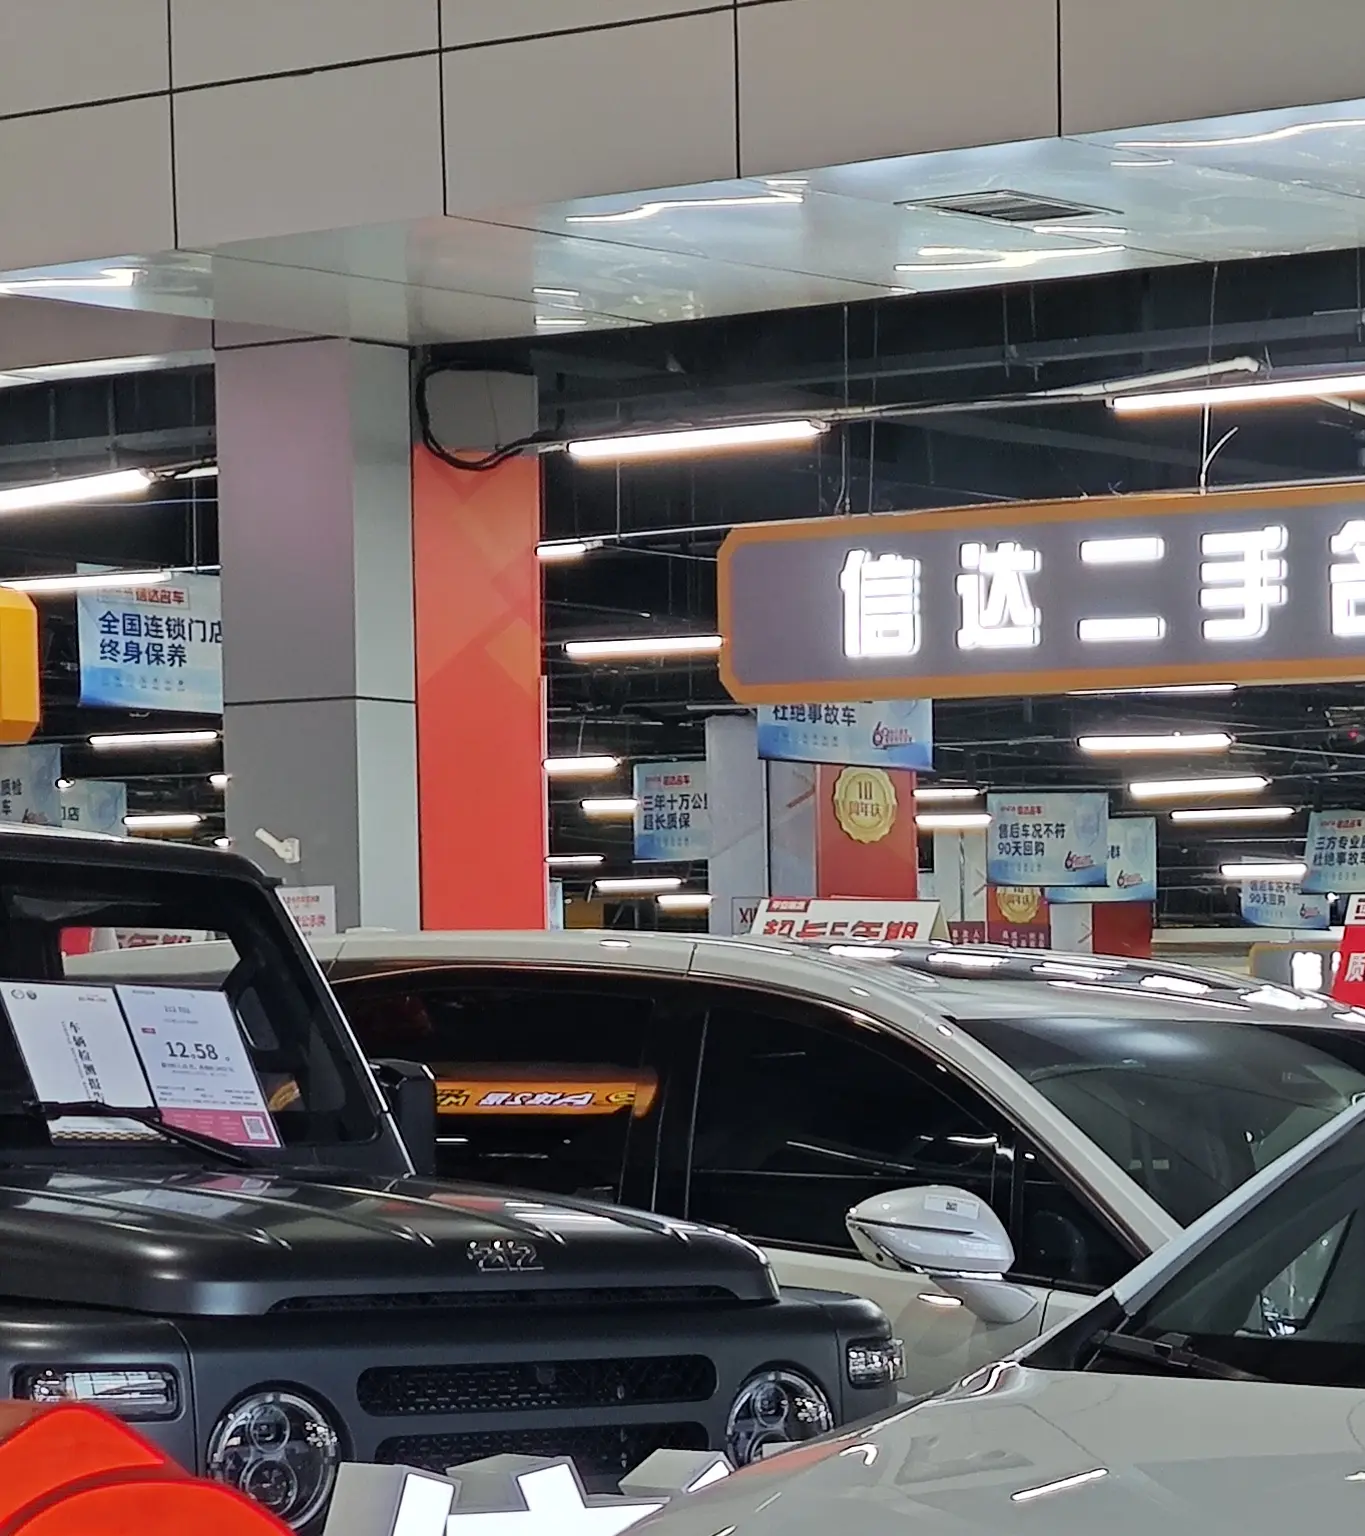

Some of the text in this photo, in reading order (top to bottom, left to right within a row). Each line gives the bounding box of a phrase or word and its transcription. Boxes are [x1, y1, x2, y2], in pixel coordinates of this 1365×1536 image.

[99, 610, 223, 643] 全国连锁门店
[99, 638, 188, 668] 终身保养
[643, 793, 708, 811] 三年十万公
[998, 822, 1067, 839] 售后车况不符
[165, 1041, 220, 1061] 12.58
